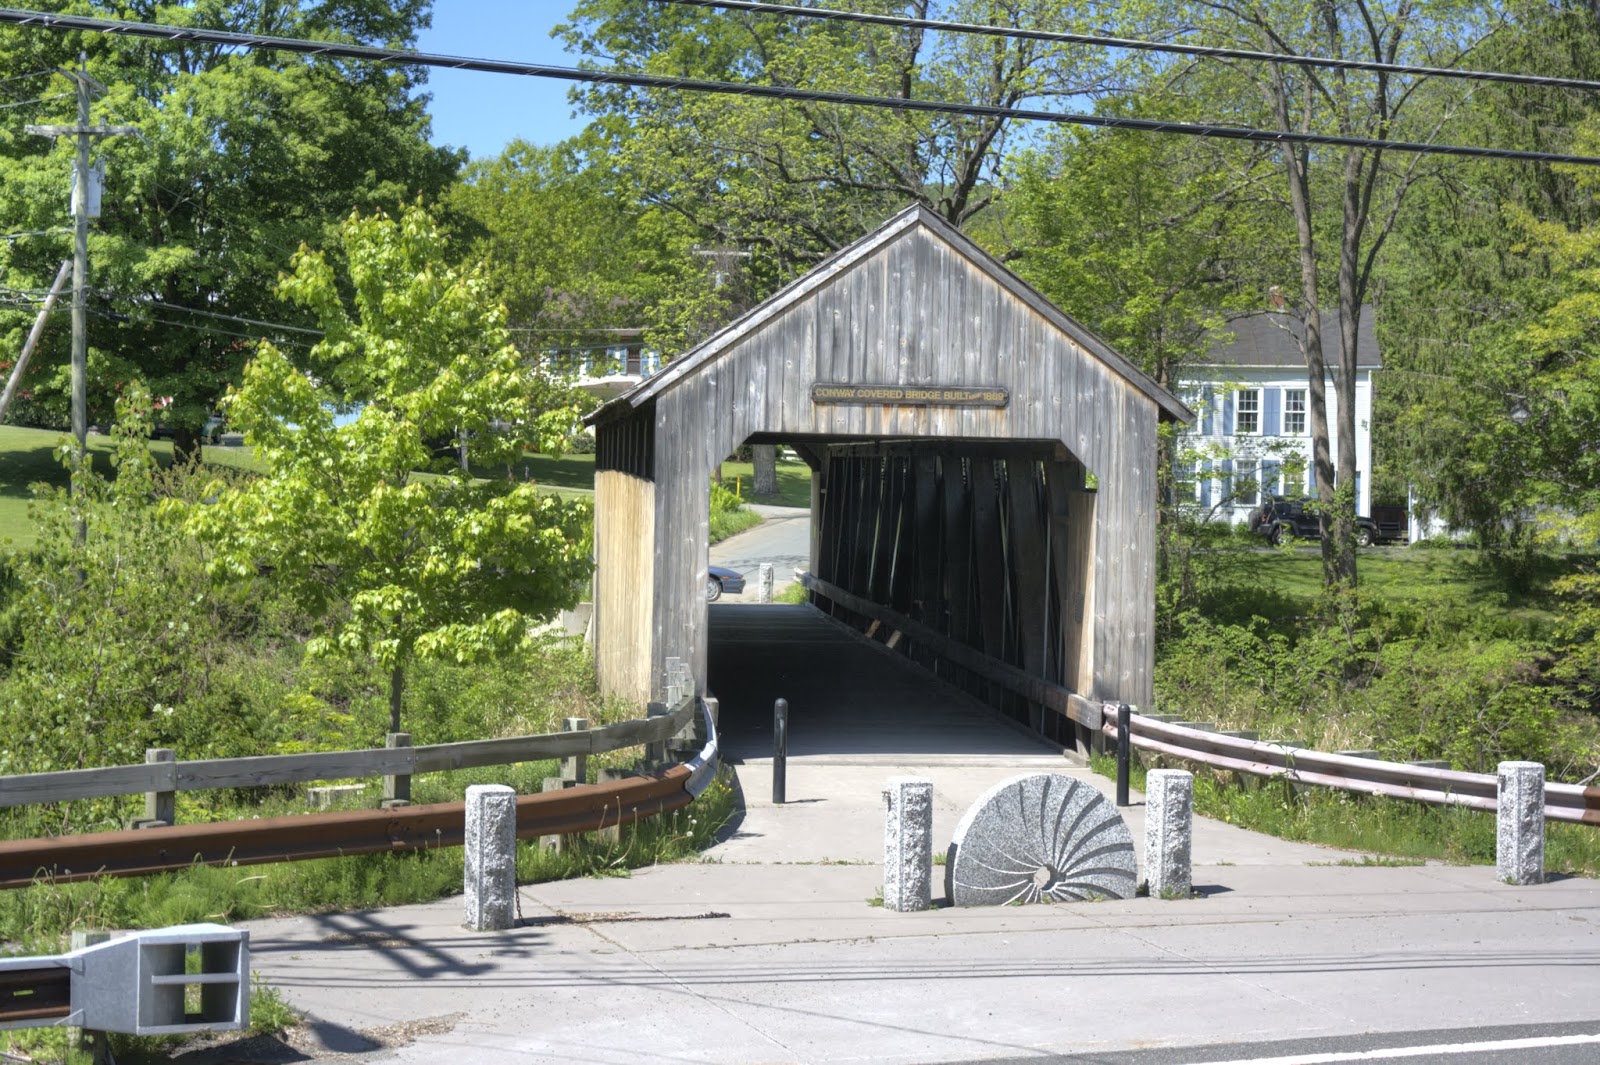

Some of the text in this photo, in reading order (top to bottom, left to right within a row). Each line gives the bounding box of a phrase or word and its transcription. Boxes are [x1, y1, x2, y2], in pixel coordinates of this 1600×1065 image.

[815, 388, 856, 397] CONWAY
[857, 389, 903, 399] COVERED
[905, 390, 941, 399] BRIDGE
[944, 391, 971, 400] BUILT
